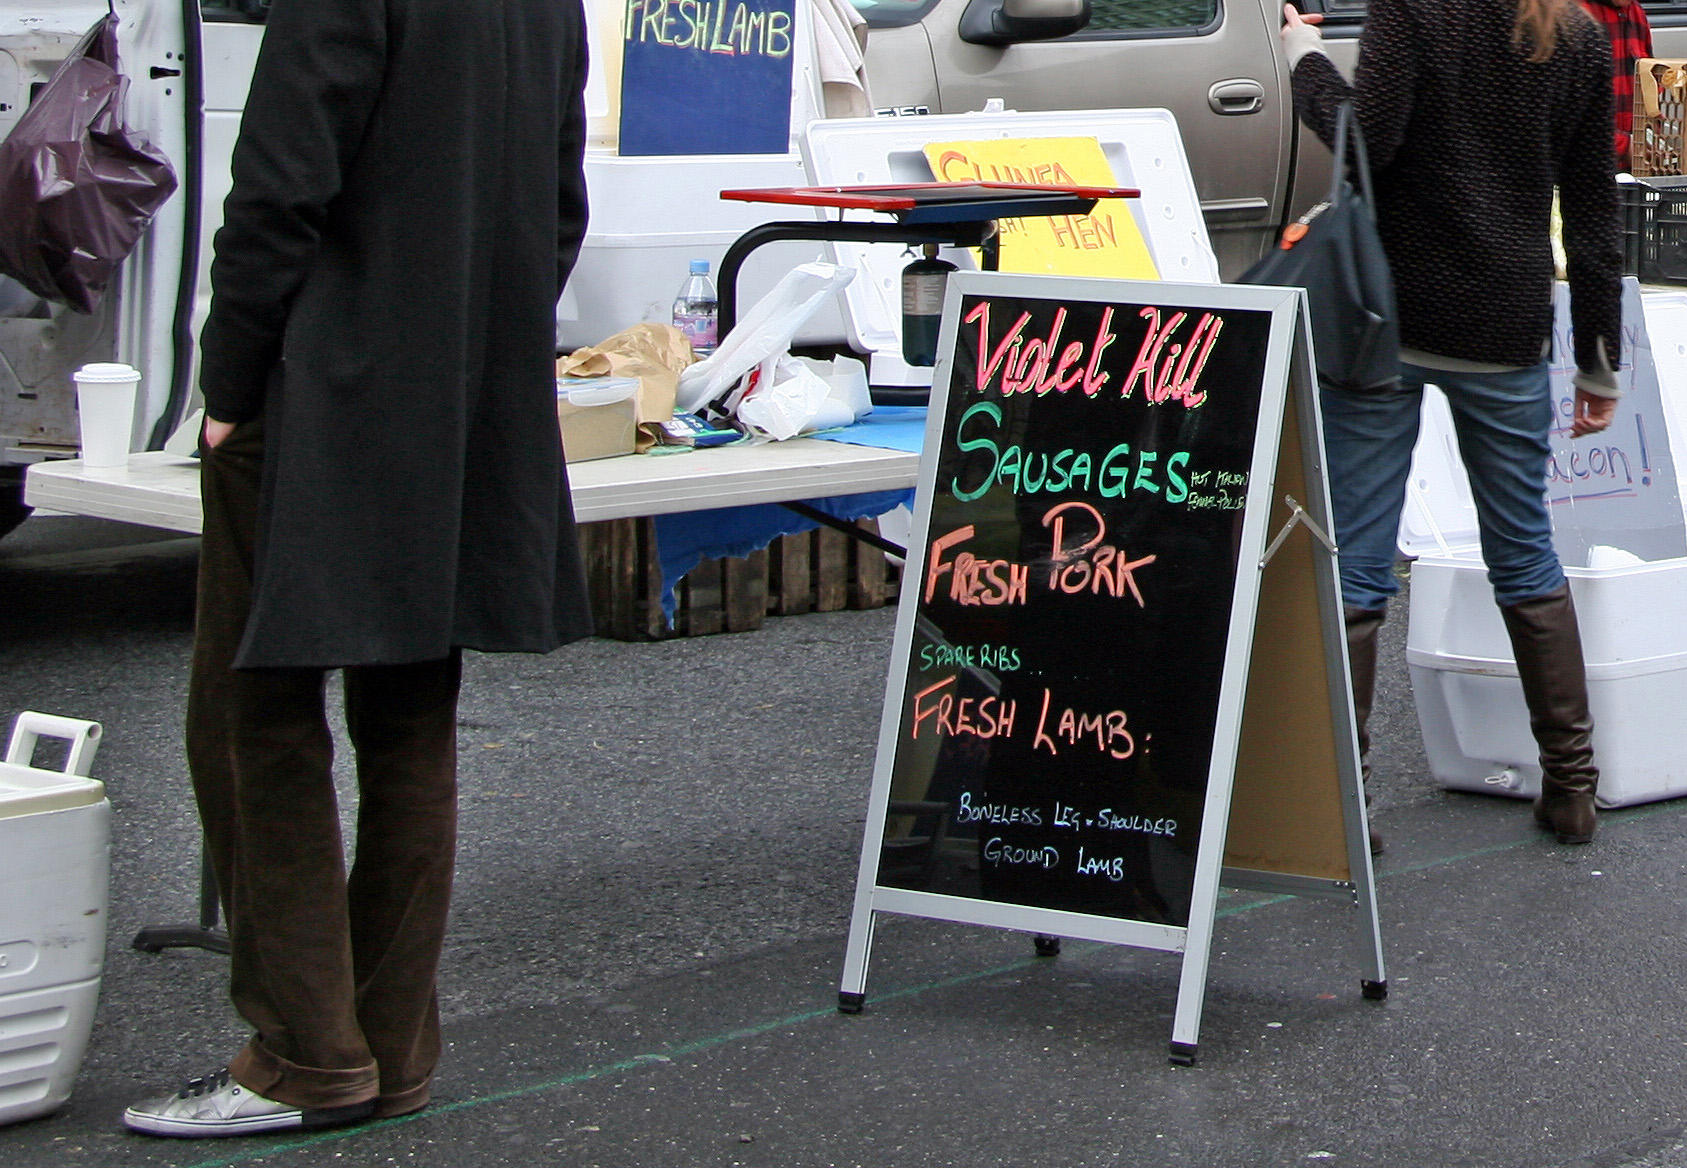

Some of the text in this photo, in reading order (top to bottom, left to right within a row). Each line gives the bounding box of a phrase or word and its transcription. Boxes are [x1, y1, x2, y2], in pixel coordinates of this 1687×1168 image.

[1048, 213, 1118, 250] HEN
[965, 301, 1224, 409] Violet Hill
[951, 401, 1191, 503] SAUSAGES
[925, 501, 1157, 608] FRESH PORK
[912, 675, 1016, 739] FRESH
[957, 792, 1178, 837] BONELESS LEG SHOULDER
[984, 837, 1125, 882] GROUND LAMB
